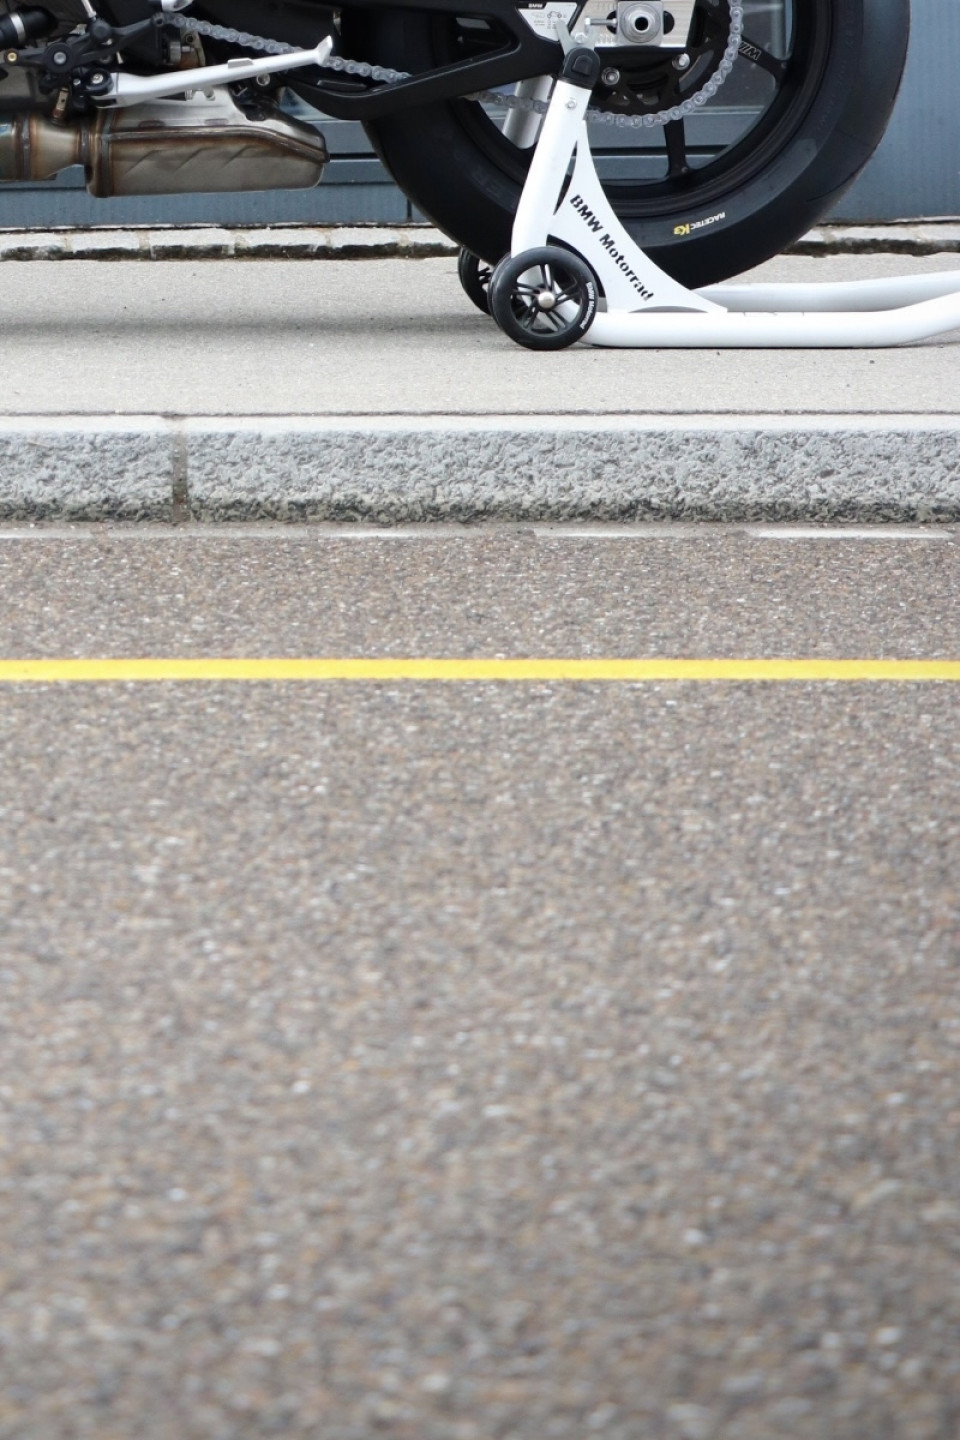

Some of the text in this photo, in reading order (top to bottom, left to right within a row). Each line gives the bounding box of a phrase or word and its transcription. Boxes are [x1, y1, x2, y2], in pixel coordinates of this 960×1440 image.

[690, 211, 726, 230] RACETEC
[569, 194, 654, 301] BMW Motorrad
[586, 282, 595, 300] BMW
